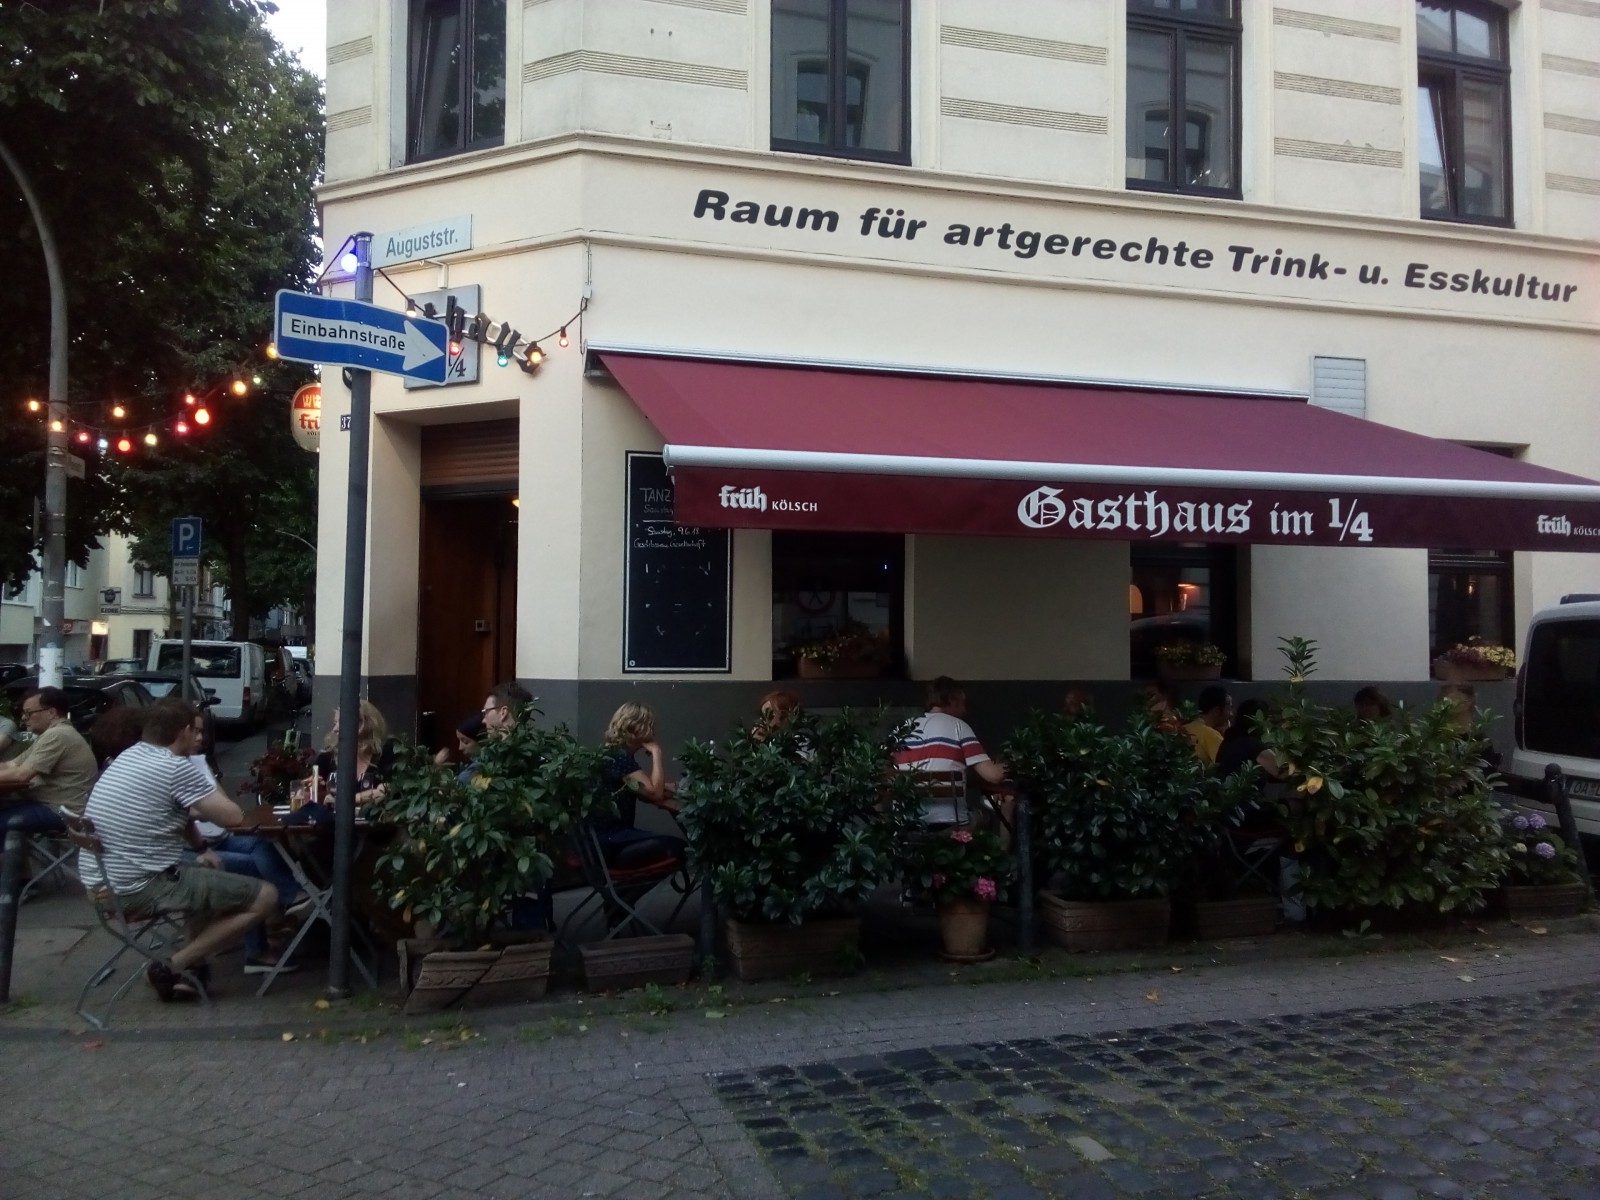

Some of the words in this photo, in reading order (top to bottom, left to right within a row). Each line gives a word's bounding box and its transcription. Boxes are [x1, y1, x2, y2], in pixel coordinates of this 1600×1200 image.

[385, 227, 458, 259] Auguststr.
[693, 188, 839, 232] Raum
[860, 207, 927, 241] für
[943, 222, 1214, 269] artgerechte
[1228, 245, 1348, 280] Trink-
[1358, 263, 1389, 286] u.
[1404, 262, 1578, 303] Esskultur
[291, 318, 406, 351] Einbahnstraße
[639, 487, 672, 503] TANZ
[718, 485, 768, 512] früh
[772, 500, 818, 512] KÖLSCH
[1017, 485, 1253, 538] Gasthaus
[1269, 502, 1314, 536] im
[1328, 497, 1374, 542] 1/4
[1536, 514, 1571, 537] früh
[179, 523, 194, 551] P
